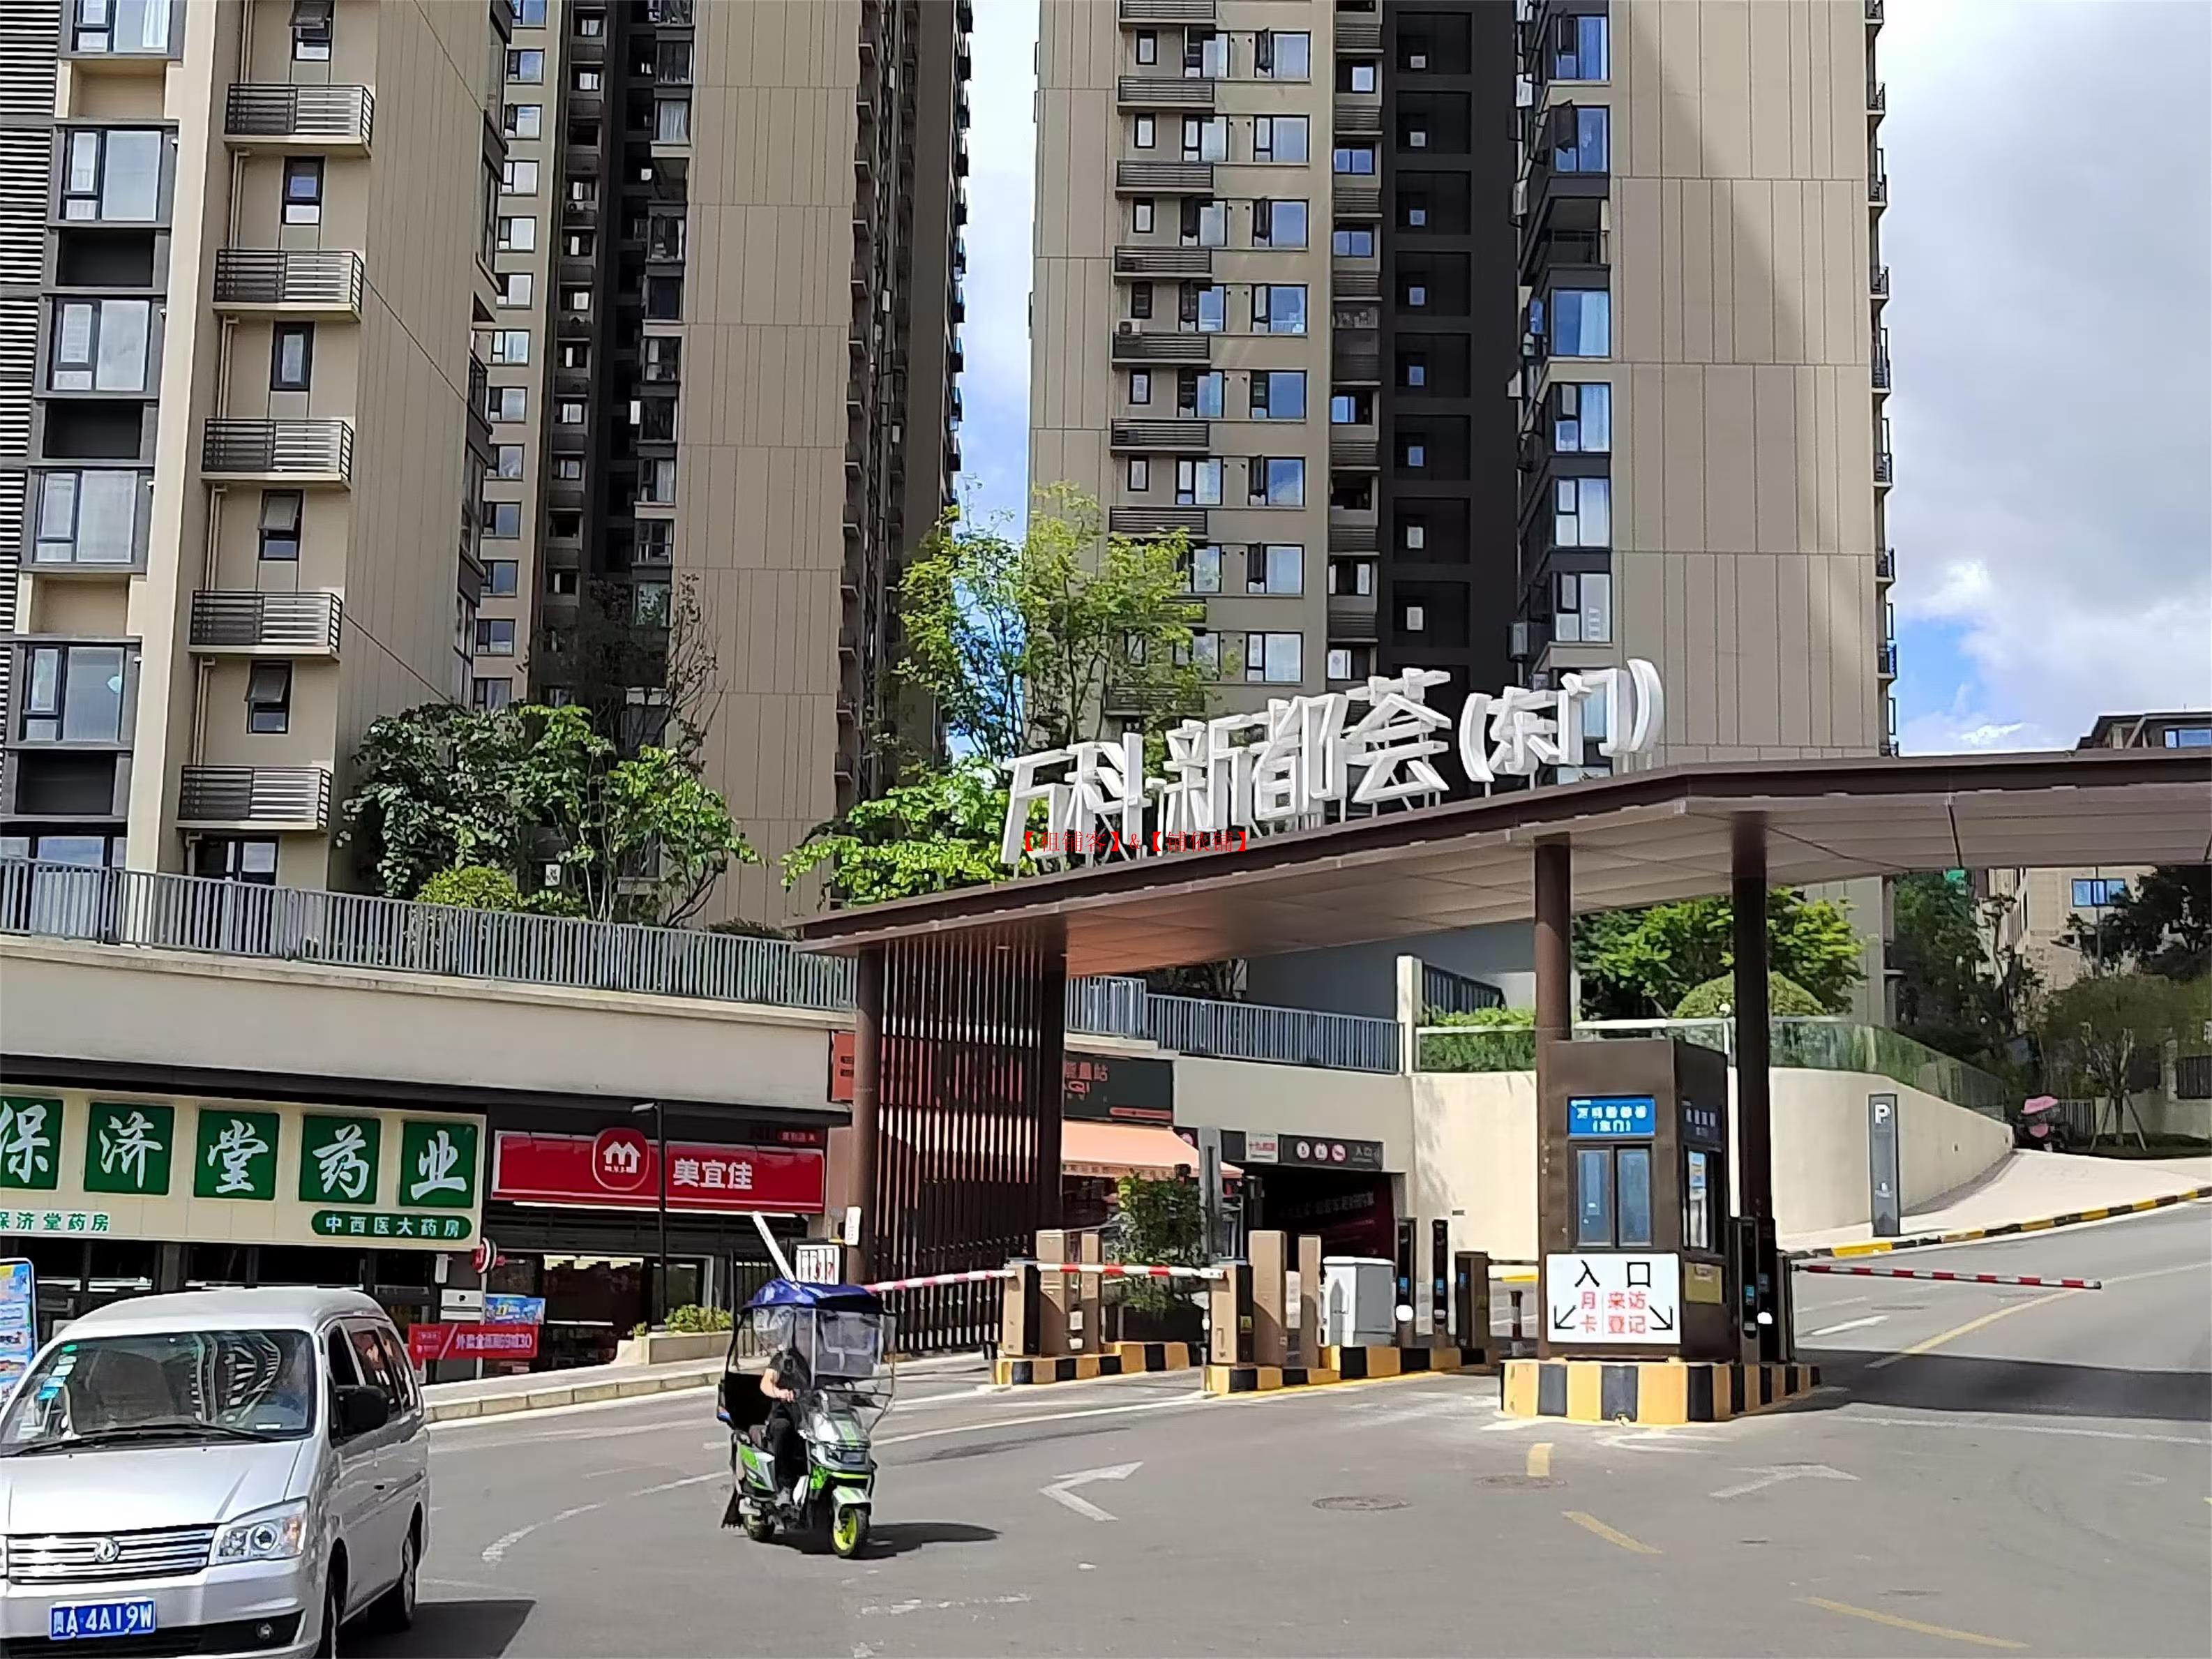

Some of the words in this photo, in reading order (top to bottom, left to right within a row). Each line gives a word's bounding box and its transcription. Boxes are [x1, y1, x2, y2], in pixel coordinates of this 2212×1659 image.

[1874, 1104, 1890, 1125] P
[0, 1101, 467, 1201] 保济堂药业
[672, 1158, 753, 1189] 美宜佳
[326, 1215, 460, 1238] 中西医大药房
[1574, 1260, 1651, 1288] 入口
